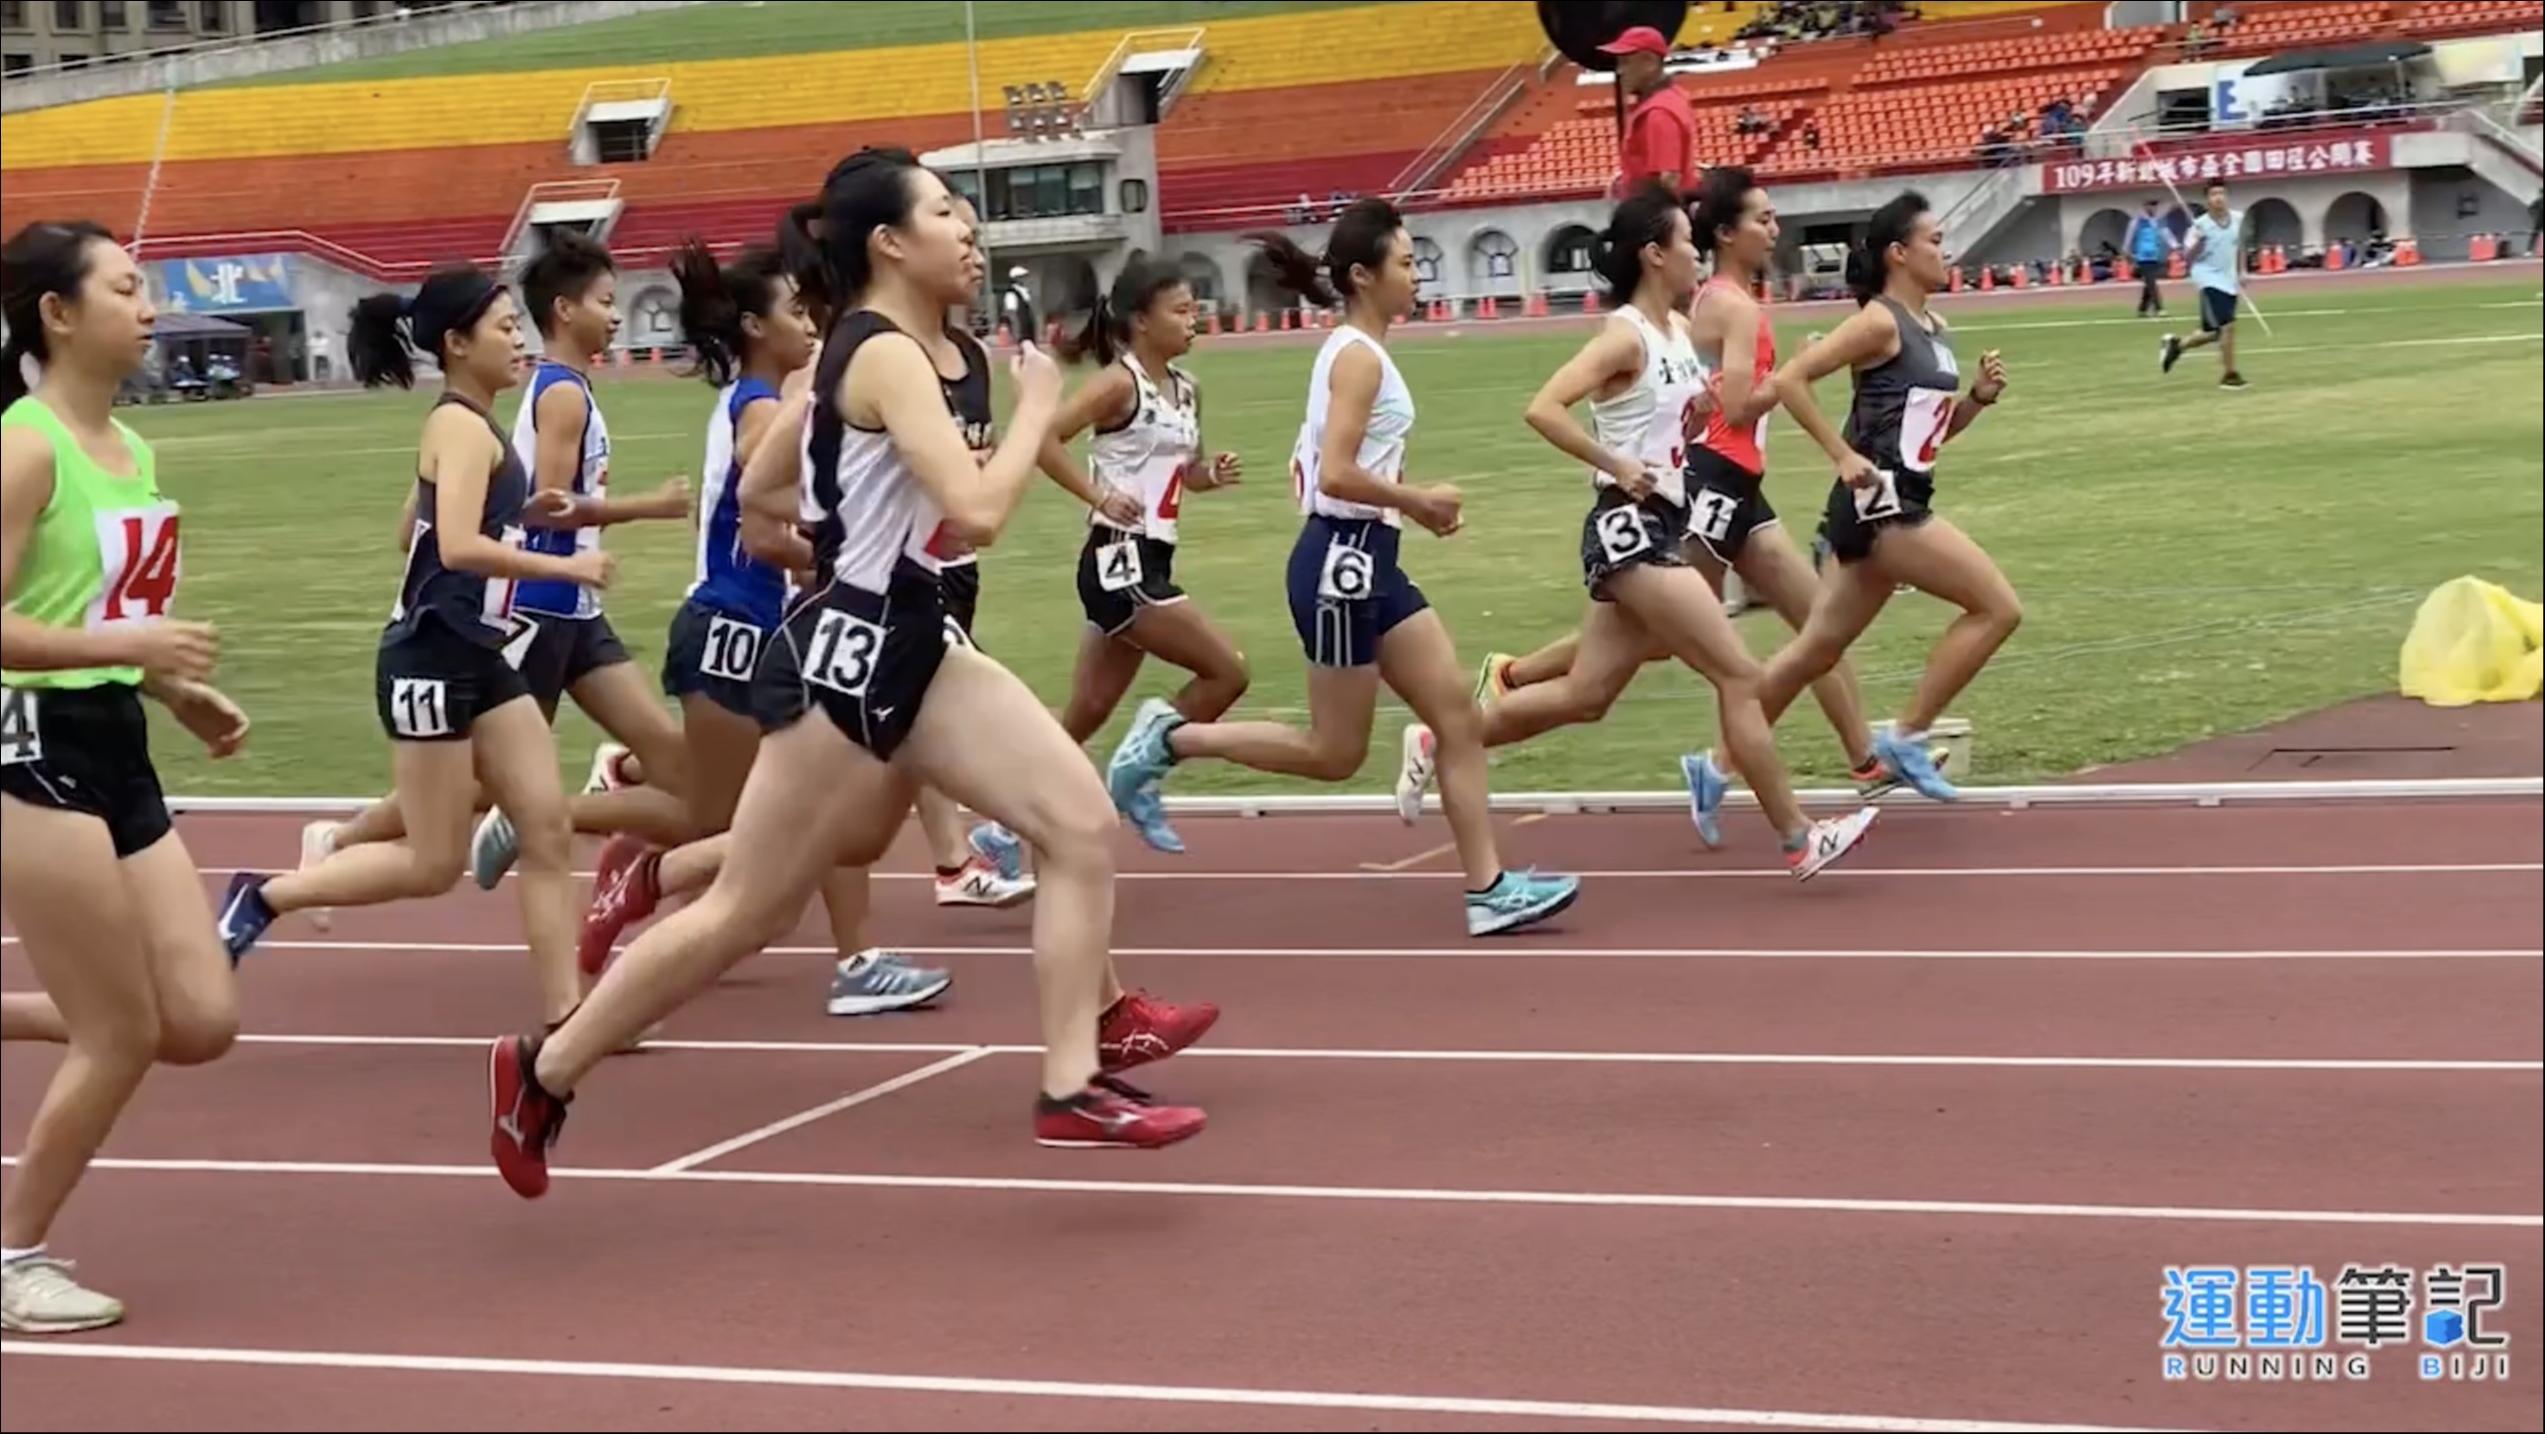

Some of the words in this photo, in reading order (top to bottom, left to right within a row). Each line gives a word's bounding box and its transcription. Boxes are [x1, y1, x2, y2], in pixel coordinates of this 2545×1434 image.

[1605, 510, 1641, 554] 3
[1706, 497, 1725, 533] 1
[103, 514, 179, 621] 14
[1104, 544, 1136, 582] 4
[1332, 551, 1365, 595] 6
[708, 622, 755, 676] 10
[813, 615, 877, 689] 13
[399, 683, 439, 732] 11
